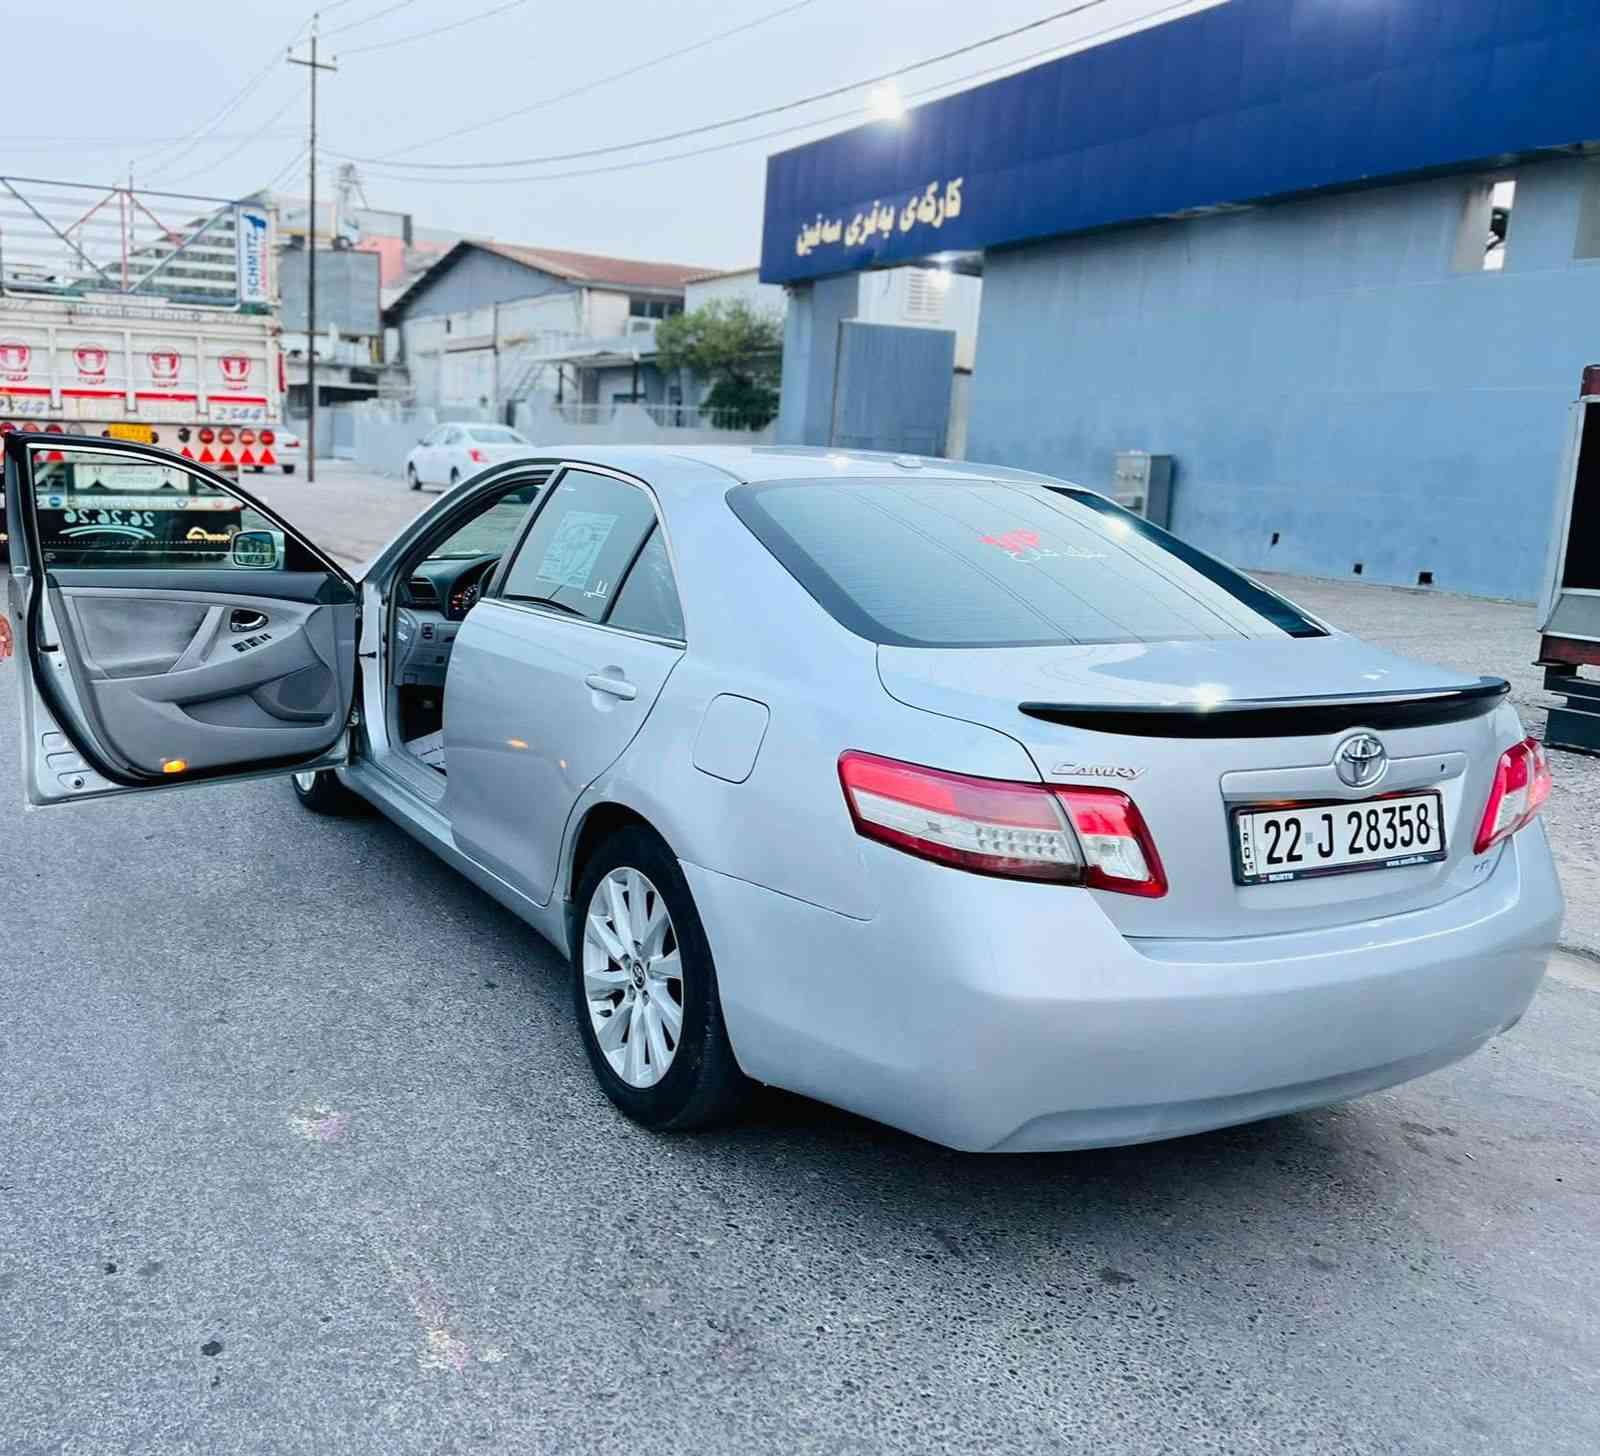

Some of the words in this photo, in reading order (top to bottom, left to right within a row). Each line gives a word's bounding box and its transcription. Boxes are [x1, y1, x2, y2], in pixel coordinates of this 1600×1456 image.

[246, 231, 258, 298] SCHMITZ
[1264, 817, 1303, 865] 22
[1318, 813, 1334, 858] J
[1347, 803, 1431, 855] 28358
